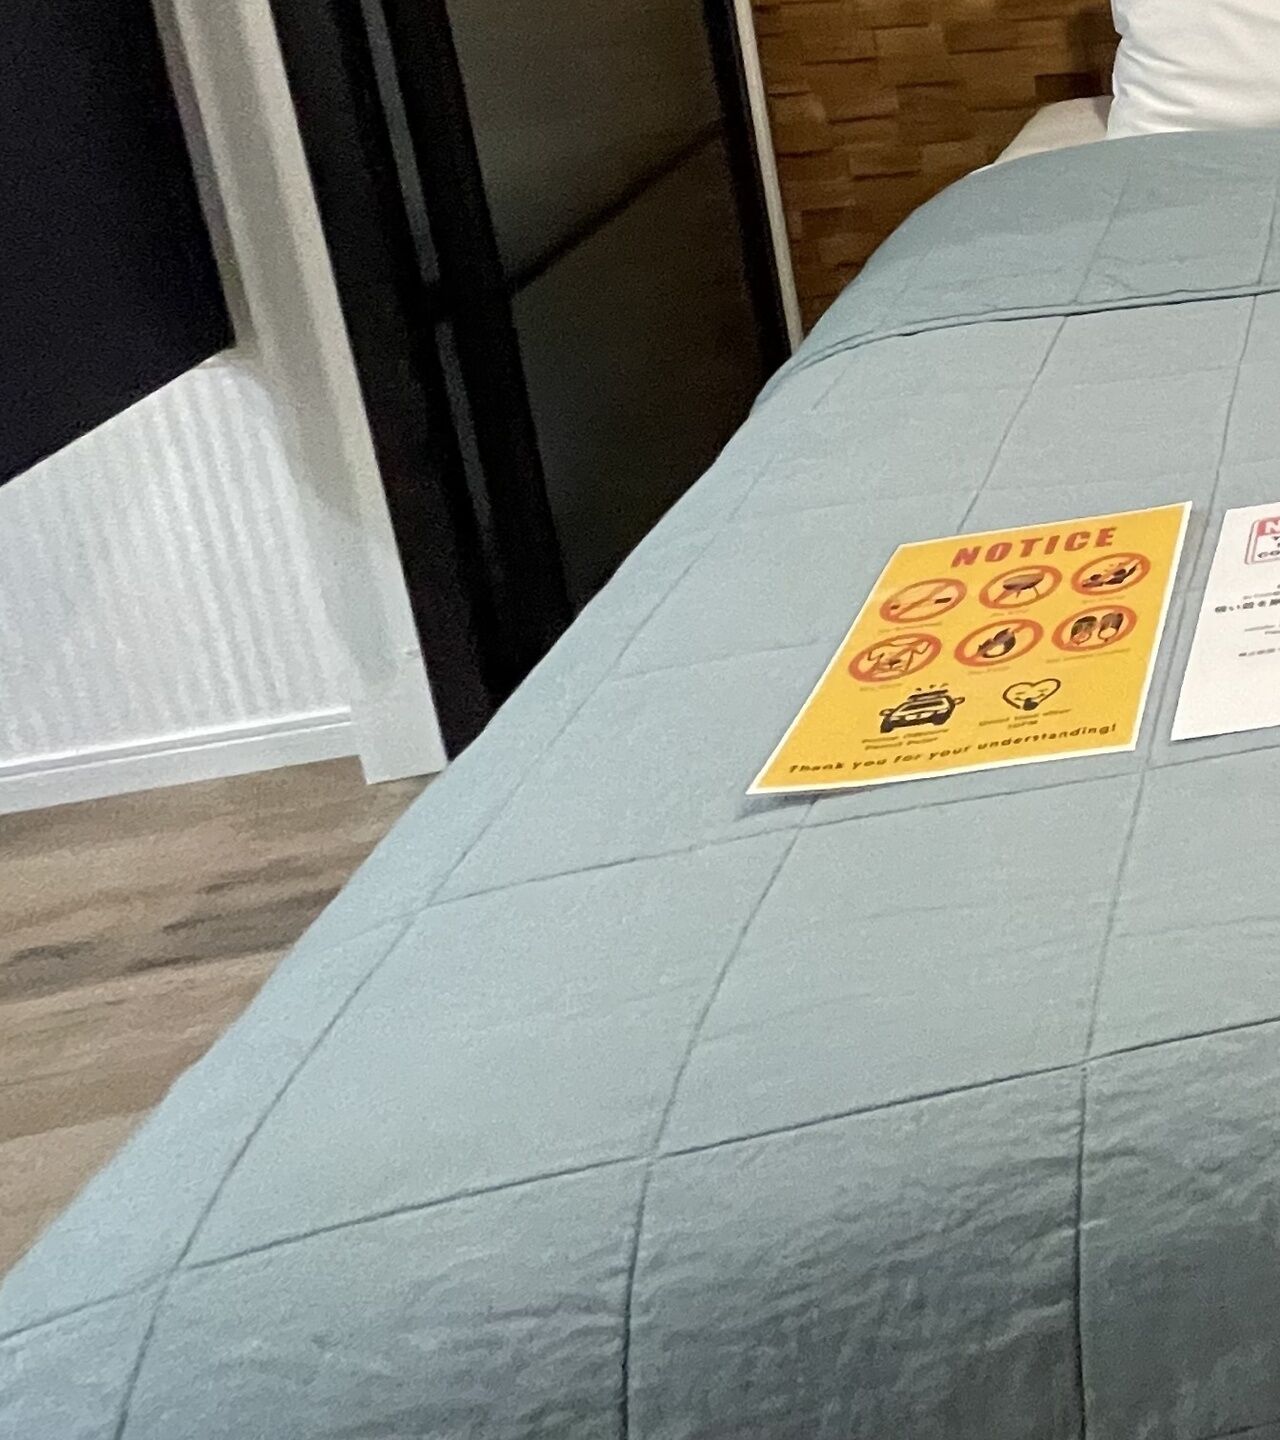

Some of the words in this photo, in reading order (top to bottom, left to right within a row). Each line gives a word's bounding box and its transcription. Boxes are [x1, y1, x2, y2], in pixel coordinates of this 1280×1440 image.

[950, 526, 1118, 568] NOTICE
[788, 762, 845, 773] Thank
[852, 758, 888, 771] you
[894, 753, 924, 764] for
[928, 745, 973, 761] your
[977, 723, 1117, 751] understanding!
